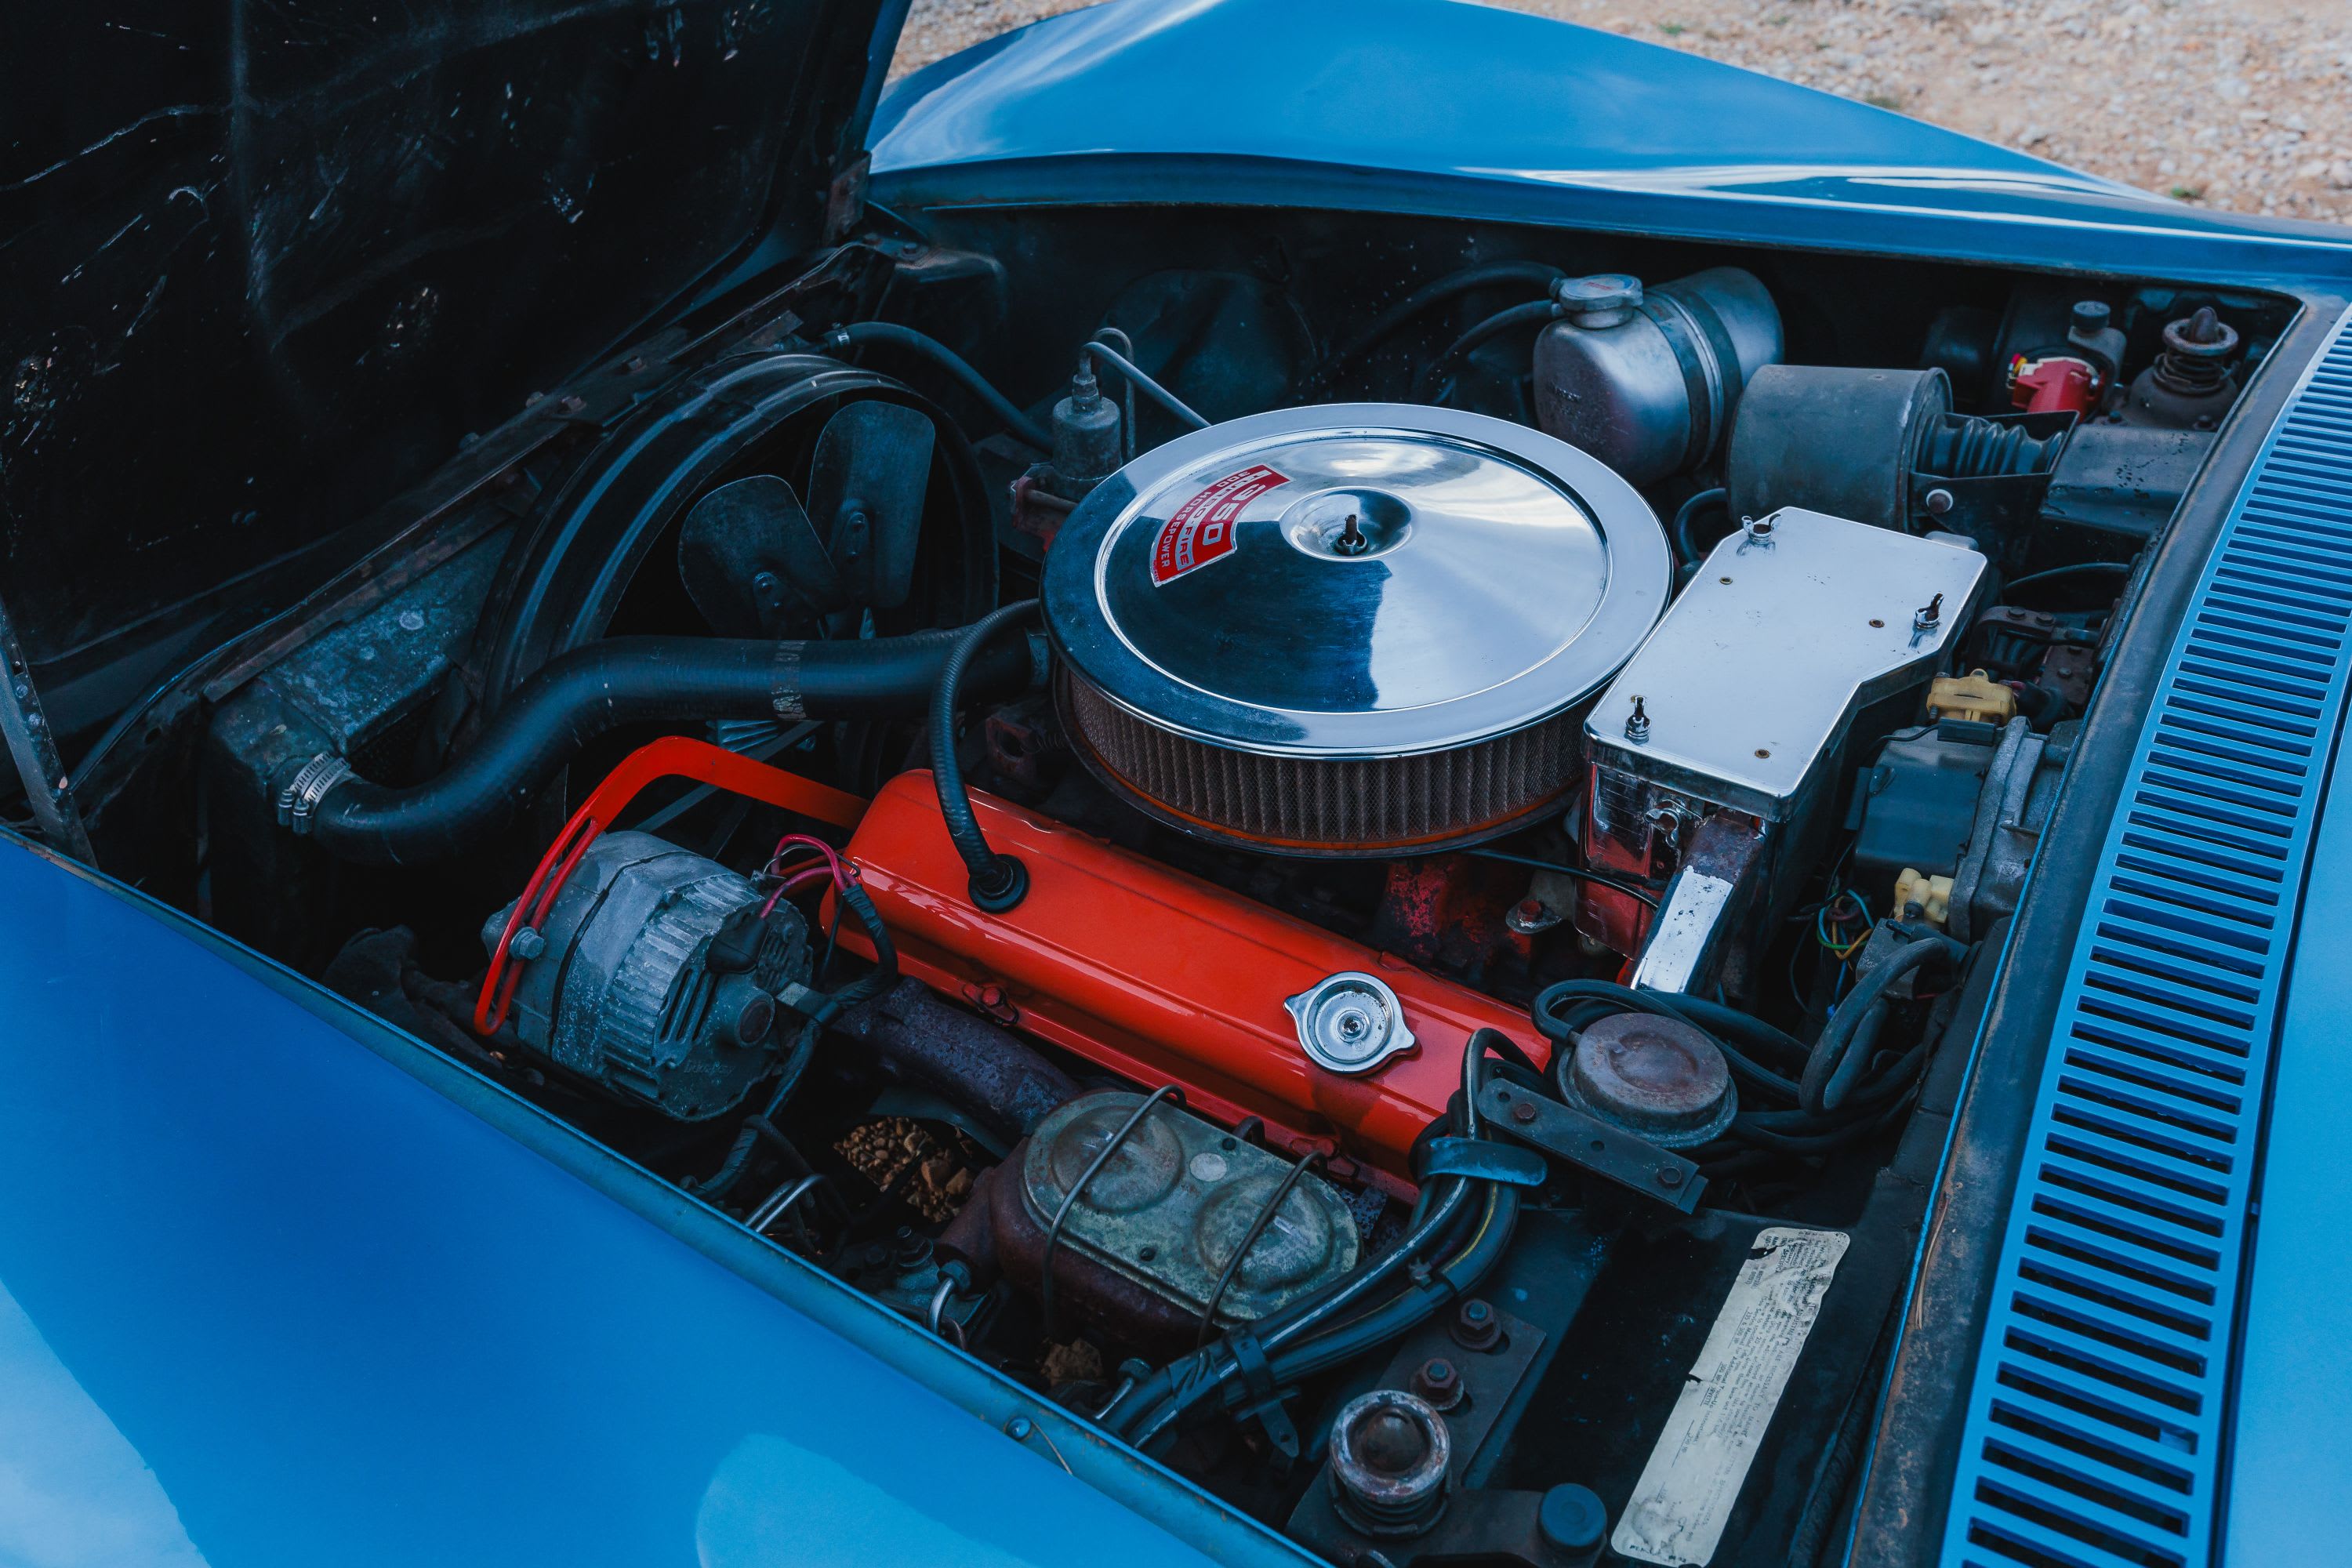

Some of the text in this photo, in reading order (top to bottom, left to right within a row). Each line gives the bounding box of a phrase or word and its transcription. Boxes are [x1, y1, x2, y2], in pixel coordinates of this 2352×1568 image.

[1160, 471, 1251, 568] 300 HORSEPOWER
[1179, 472, 1267, 566] TURBO-FIRE
[1203, 484, 1266, 546] 350
[1751, 1402, 1761, 1411] TO
